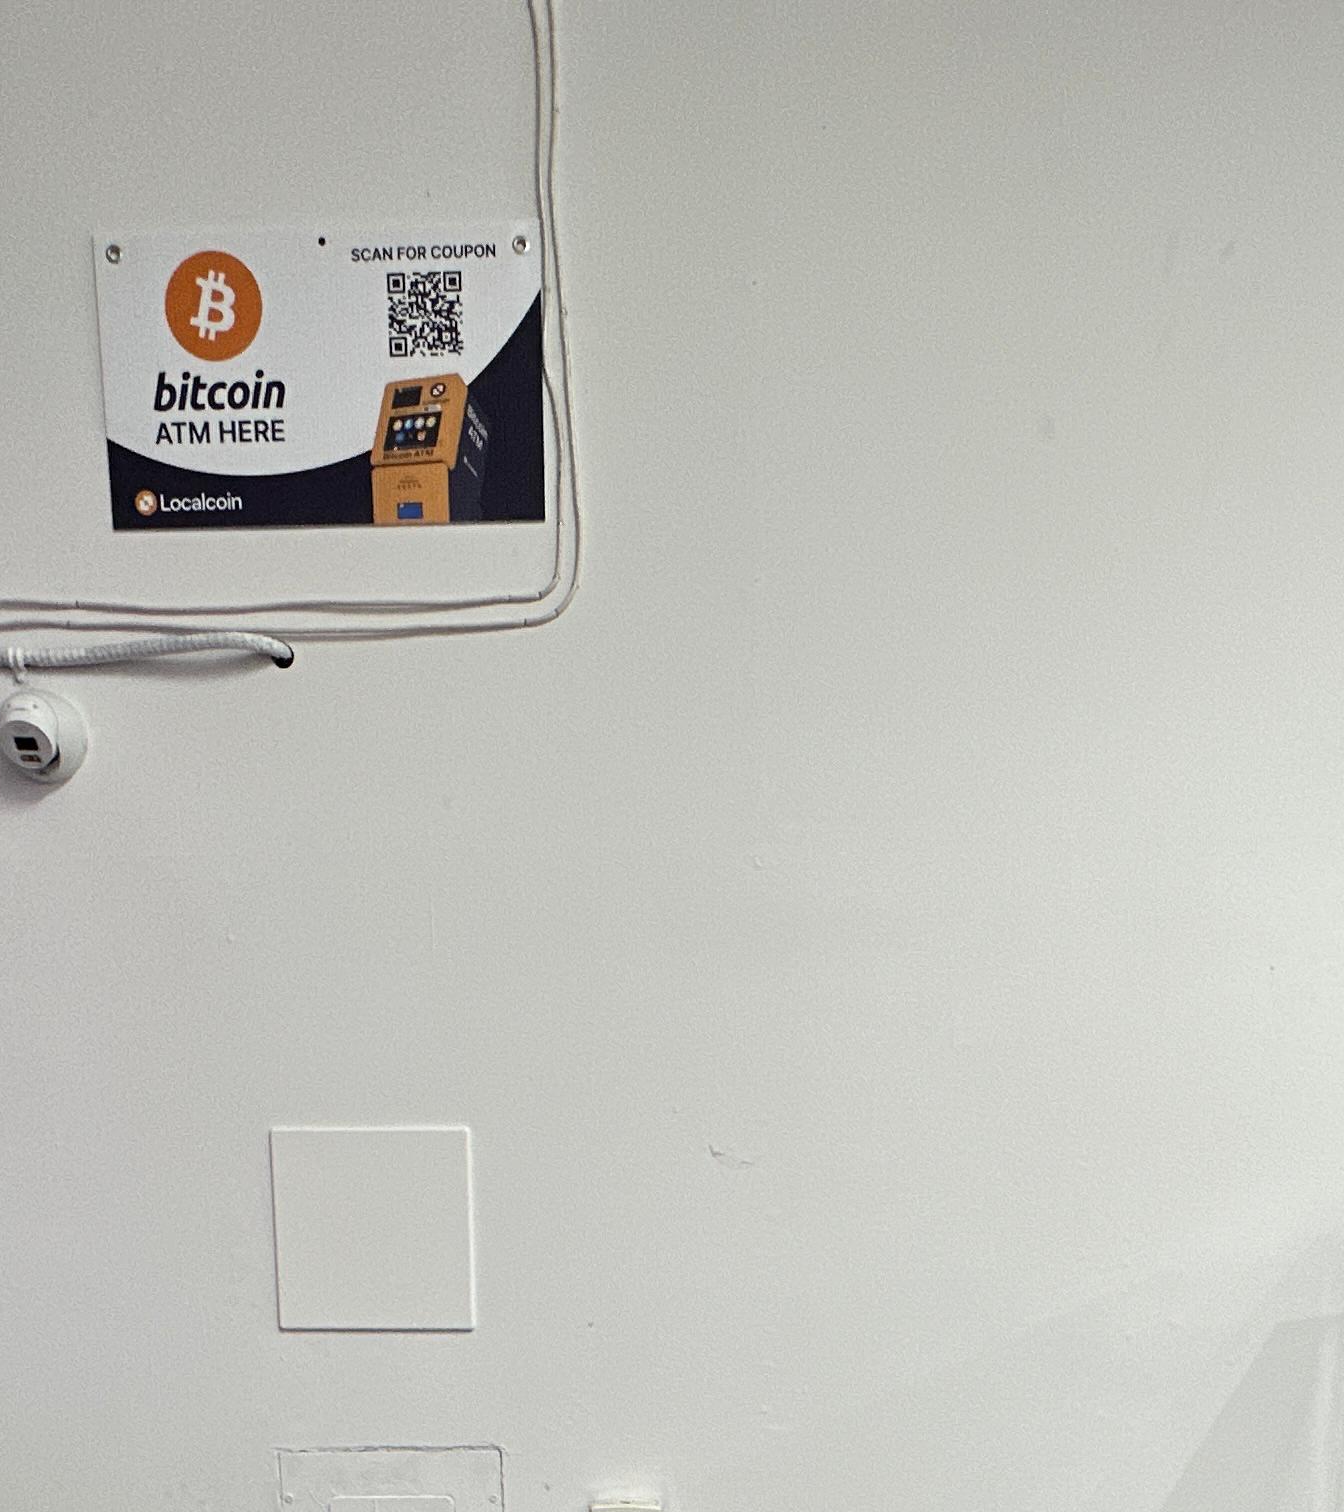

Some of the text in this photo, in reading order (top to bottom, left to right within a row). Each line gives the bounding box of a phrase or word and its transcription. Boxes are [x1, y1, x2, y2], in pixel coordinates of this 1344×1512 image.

[351, 243, 497, 262] SCAN FOR COUPON
[154, 370, 286, 412] bitcoin
[156, 419, 285, 445] ATM HERE
[160, 493, 243, 512] Localcoin
